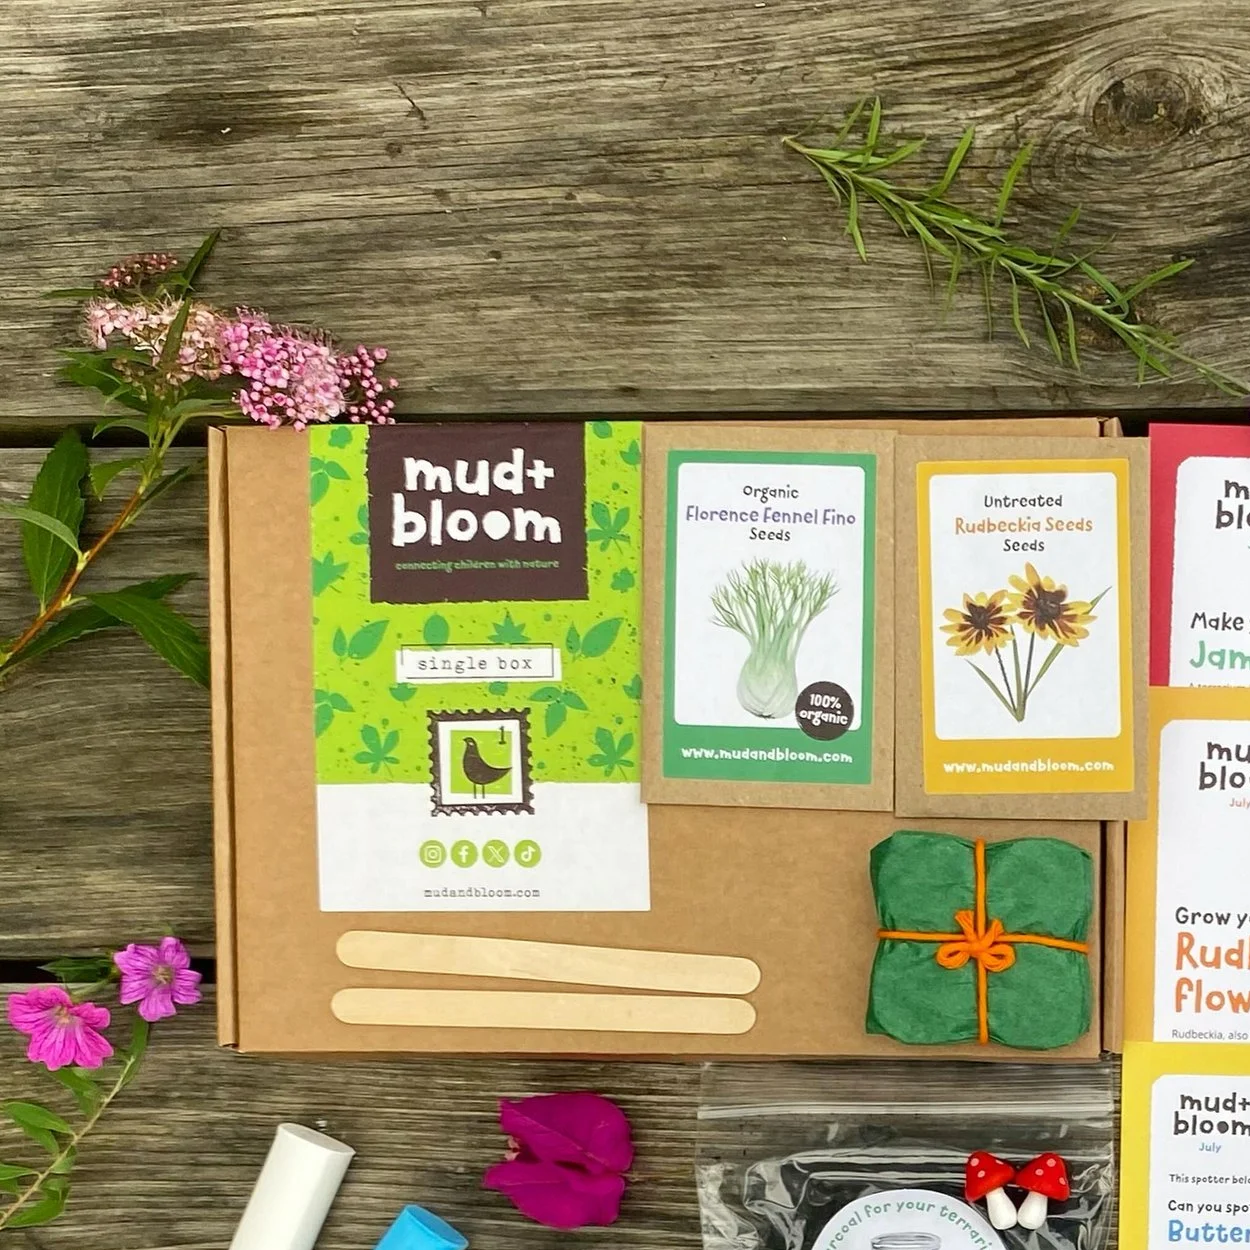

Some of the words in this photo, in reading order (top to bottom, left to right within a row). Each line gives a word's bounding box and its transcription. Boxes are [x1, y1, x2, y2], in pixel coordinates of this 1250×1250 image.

[403, 449, 554, 495] mud+
[742, 484, 799, 504] Organic
[984, 495, 1062, 508] Untreated
[392, 492, 561, 545] bloom
[685, 505, 759, 522] Florence
[763, 506, 818, 524] Fennel
[822, 508, 856, 525] Fino
[955, 516, 1041, 534] Rudbeckia
[1044, 516, 1093, 532] Seeds
[749, 527, 790, 541] Seeds
[1003, 538, 1045, 552] Seeds
[1190, 611, 1244, 631] Make
[418, 656, 487, 674] single
[497, 656, 532, 670] box
[810, 692, 843, 711] 100%
[798, 708, 851, 729] organic
[681, 747, 852, 762] www.mudandbloom.com
[941, 759, 1117, 774] www.mudandbloom.com
[424, 887, 540, 897] mudandbloom.com
[1175, 906, 1231, 925] Grow
[1172, 1029, 1225, 1040] Rudbeckia,
[1228, 1031, 1248, 1040] also
[1177, 1092, 1250, 1113] mud+
[1198, 1142, 1221, 1153] July
[1168, 1173, 1189, 1183] This
[1191, 1175, 1230, 1185] spotter
[864, 1202, 891, 1217] for
[896, 1201, 936, 1212] your
[1167, 1199, 1194, 1212] Can
[1197, 1203, 1222, 1214] you
